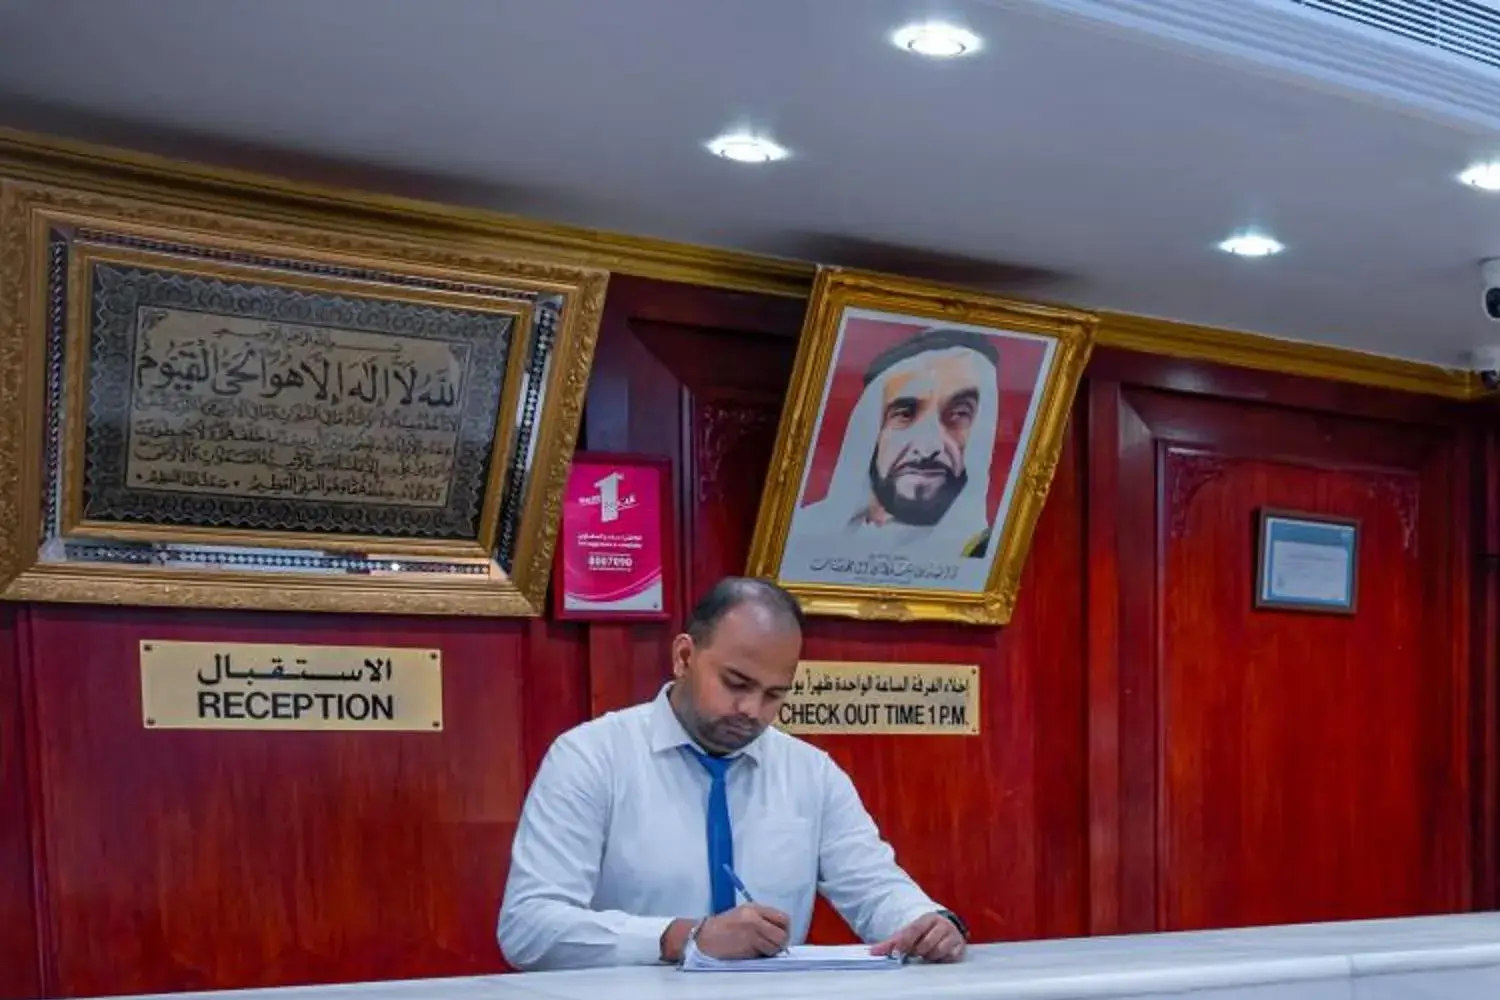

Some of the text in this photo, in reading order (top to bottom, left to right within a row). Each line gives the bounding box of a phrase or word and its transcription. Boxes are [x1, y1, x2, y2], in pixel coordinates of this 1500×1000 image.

[197, 652, 392, 686] الاستقبال
[197, 691, 394, 721] RECEPTION
[779, 702, 841, 726] CHECK
[844, 703, 881, 726] OUT
[883, 703, 926, 726] TIME
[927, 704, 936, 725] 1
